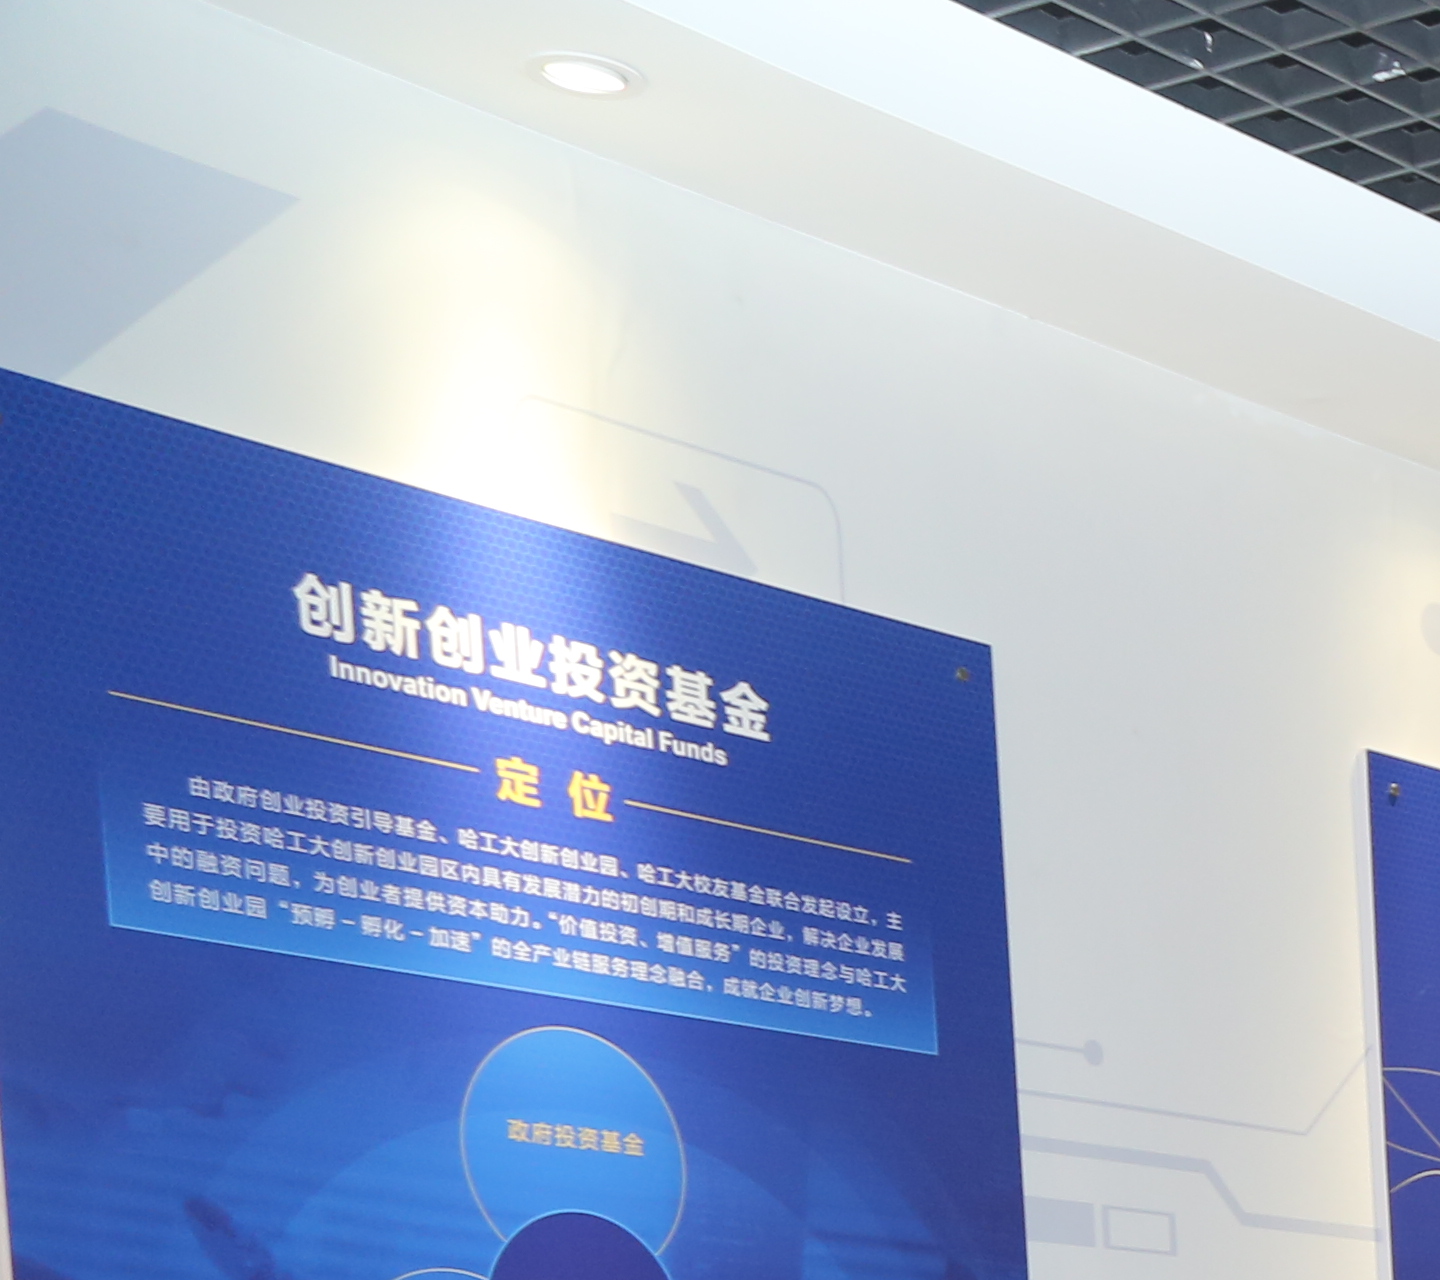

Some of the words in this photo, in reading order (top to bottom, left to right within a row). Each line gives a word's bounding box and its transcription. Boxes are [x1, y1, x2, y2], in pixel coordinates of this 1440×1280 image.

[292, 572, 772, 743] 创新创业投资基金
[329, 655, 468, 707] Innovation
[472, 687, 568, 729] Venture
[572, 710, 653, 750] Capital
[659, 734, 728, 766] Funds
[507, 1118, 645, 1157] 政府投资基金
